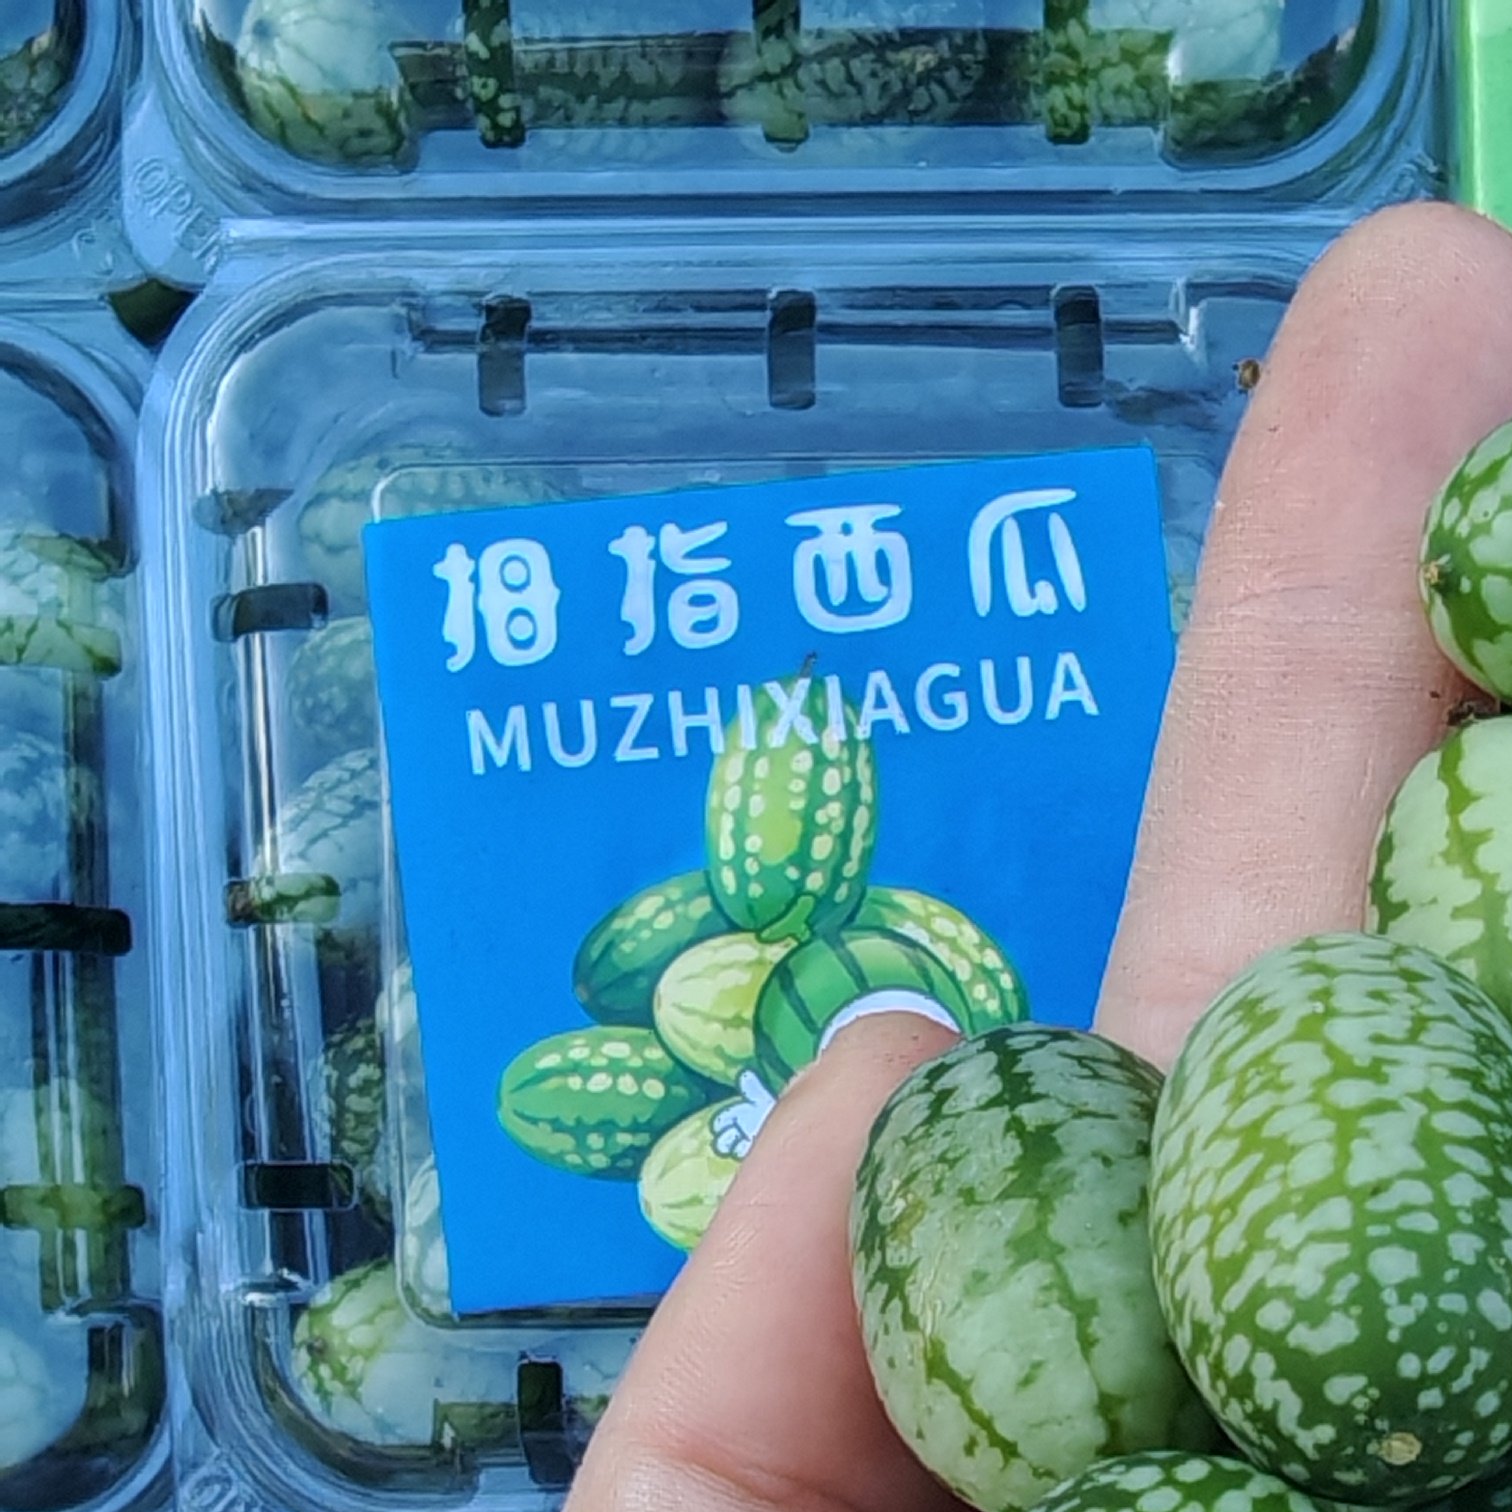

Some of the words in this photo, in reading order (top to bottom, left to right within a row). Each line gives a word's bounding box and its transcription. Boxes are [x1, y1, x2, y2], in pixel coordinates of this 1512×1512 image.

[432, 487, 1088, 673] 拇指西瓜
[467, 651, 1100, 776] MUZHIXIAGUA
